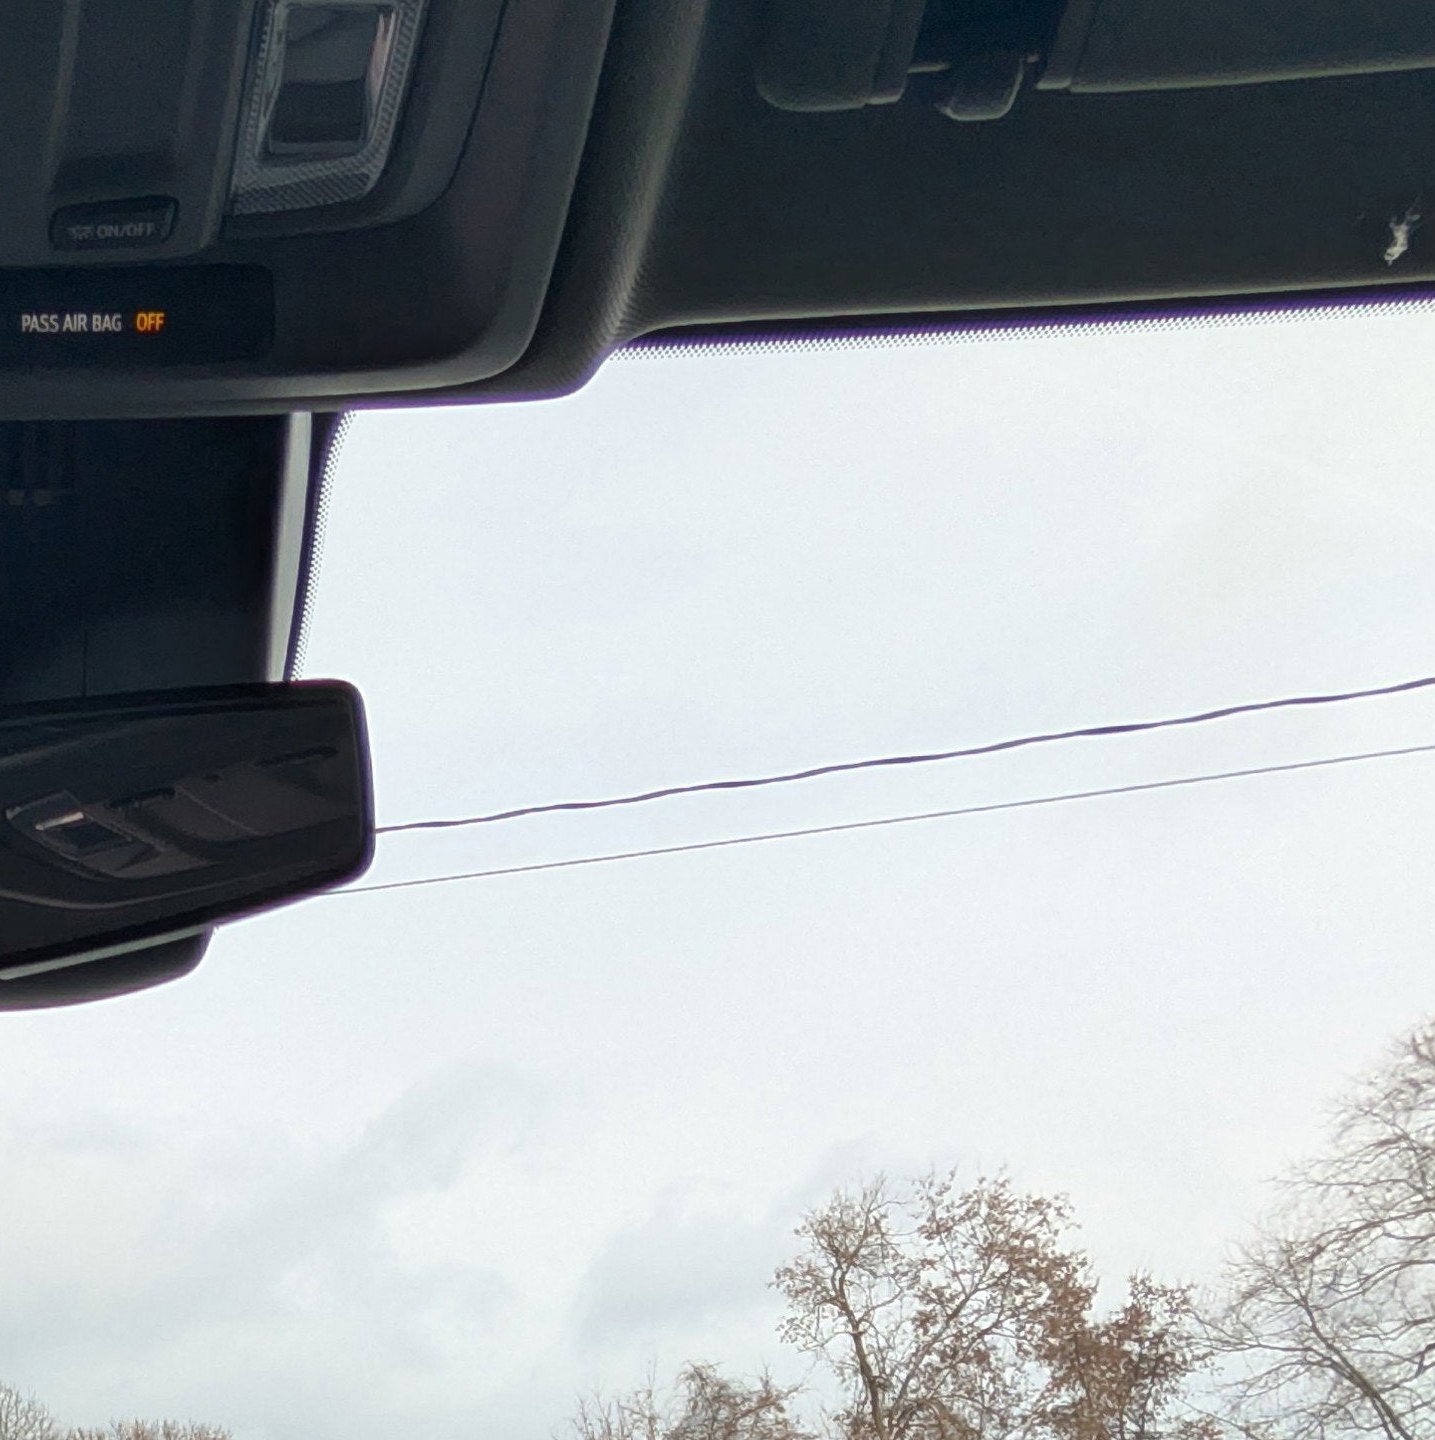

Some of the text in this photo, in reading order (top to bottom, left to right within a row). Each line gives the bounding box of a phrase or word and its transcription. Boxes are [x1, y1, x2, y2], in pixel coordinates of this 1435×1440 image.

[97, 222, 156, 239] ON/OFF
[21, 312, 165, 333] PASS AIR BAG OFF
